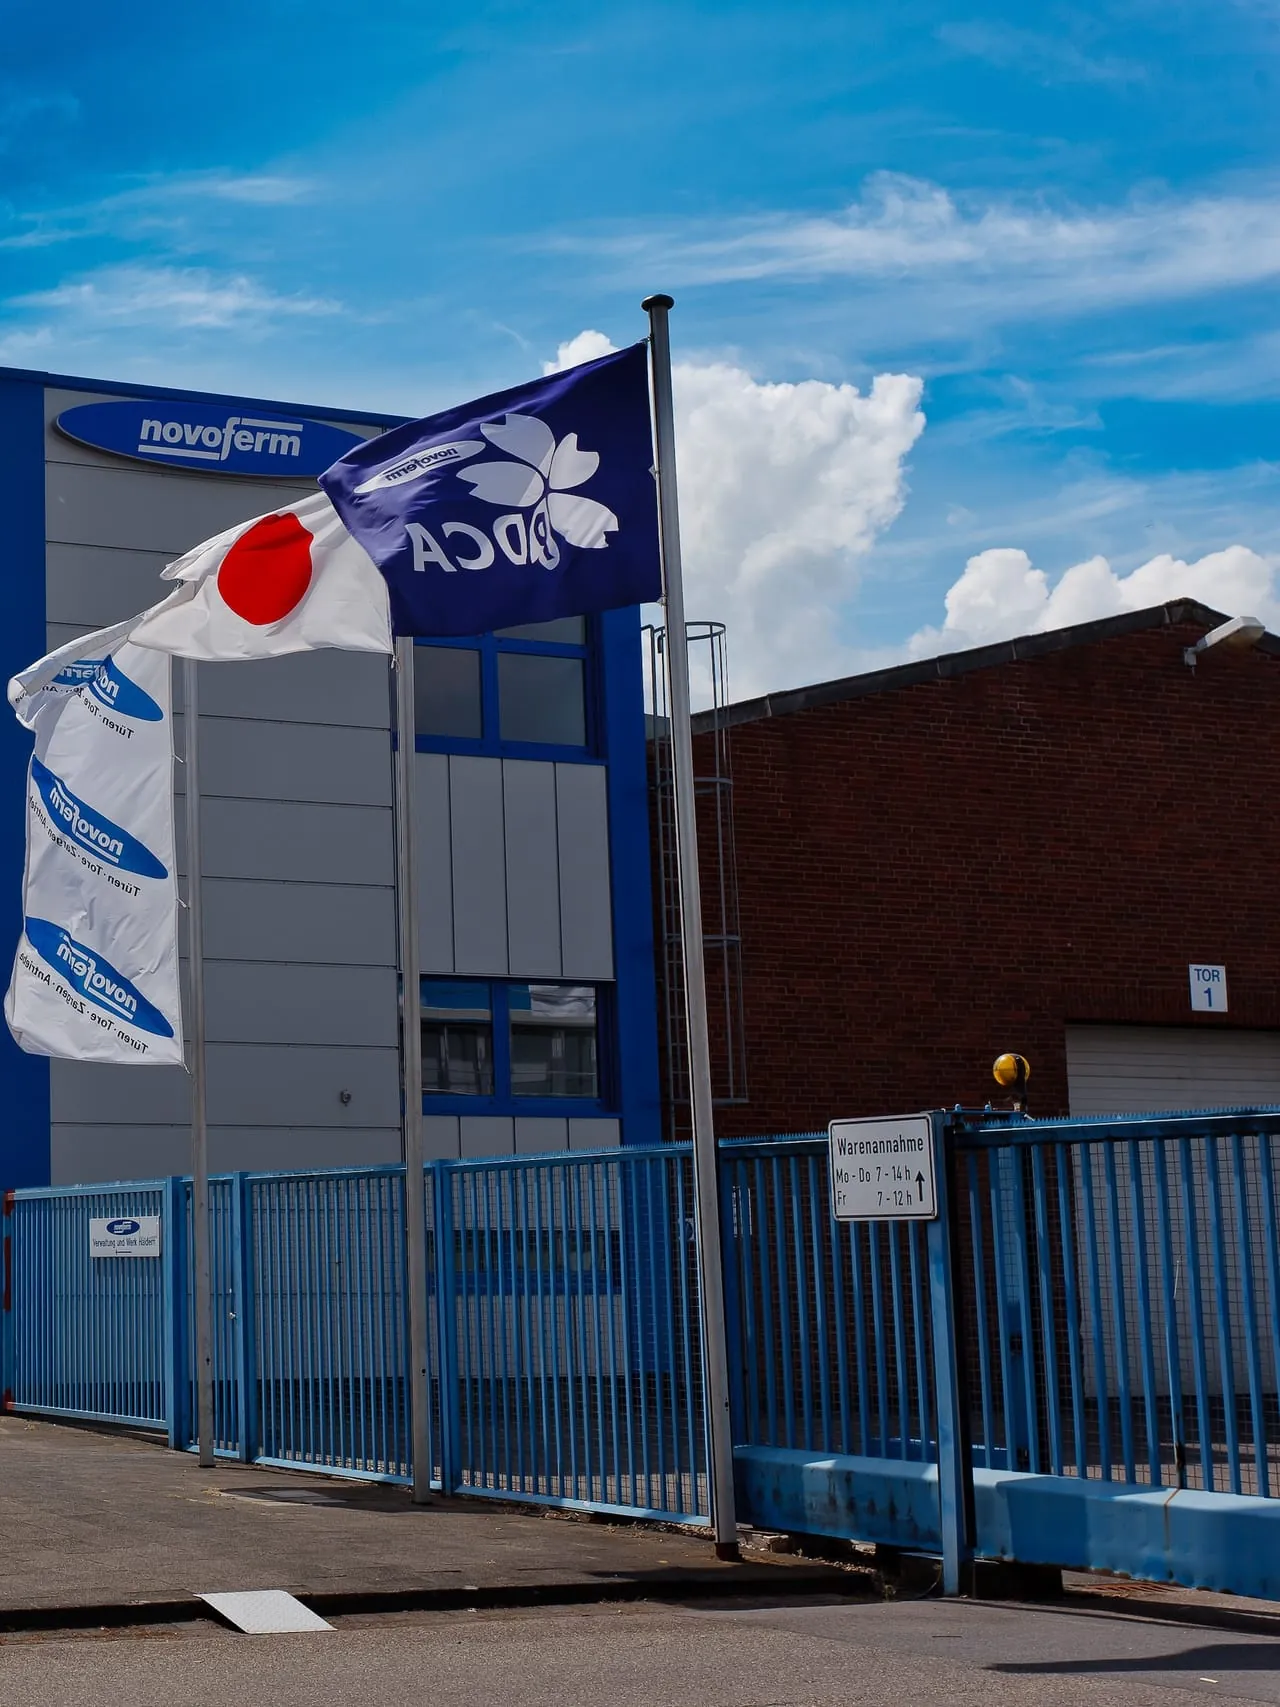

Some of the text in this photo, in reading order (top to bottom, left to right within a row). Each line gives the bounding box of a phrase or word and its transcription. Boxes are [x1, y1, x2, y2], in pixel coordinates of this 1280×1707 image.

[140, 417, 302, 461] novoferm
[1194, 968, 1220, 982] TOR
[1203, 987, 1212, 1008] 1
[837, 1134, 924, 1156] Warenannahme
[836, 1168, 849, 1183] Mo
[859, 1167, 871, 1182] Do
[876, 1166, 881, 1182] 7
[892, 1165, 902, 1181] 14
[905, 1165, 911, 1180] h
[837, 1190, 846, 1206] Fr
[877, 1191, 883, 1206] 7
[893, 1190, 903, 1206] 12
[907, 1190, 912, 1206] h
